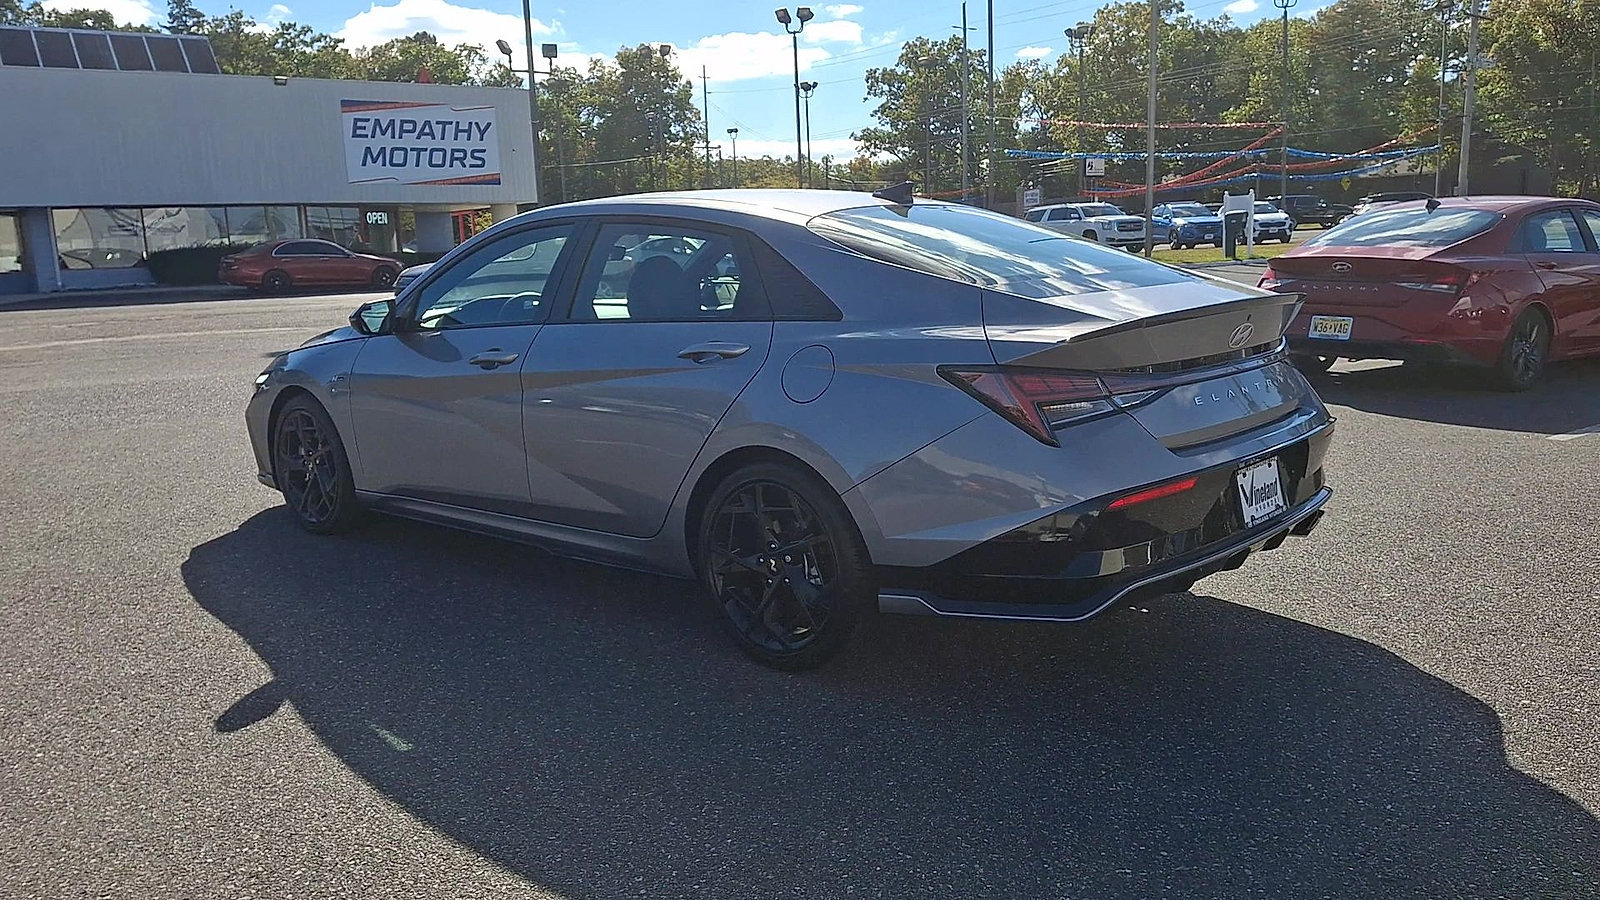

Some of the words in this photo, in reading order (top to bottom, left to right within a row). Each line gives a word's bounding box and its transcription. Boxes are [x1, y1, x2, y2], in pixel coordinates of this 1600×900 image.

[351, 117, 492, 142] EMPATHY
[361, 146, 487, 168] MOTORS
[366, 211, 388, 225] OPEN
